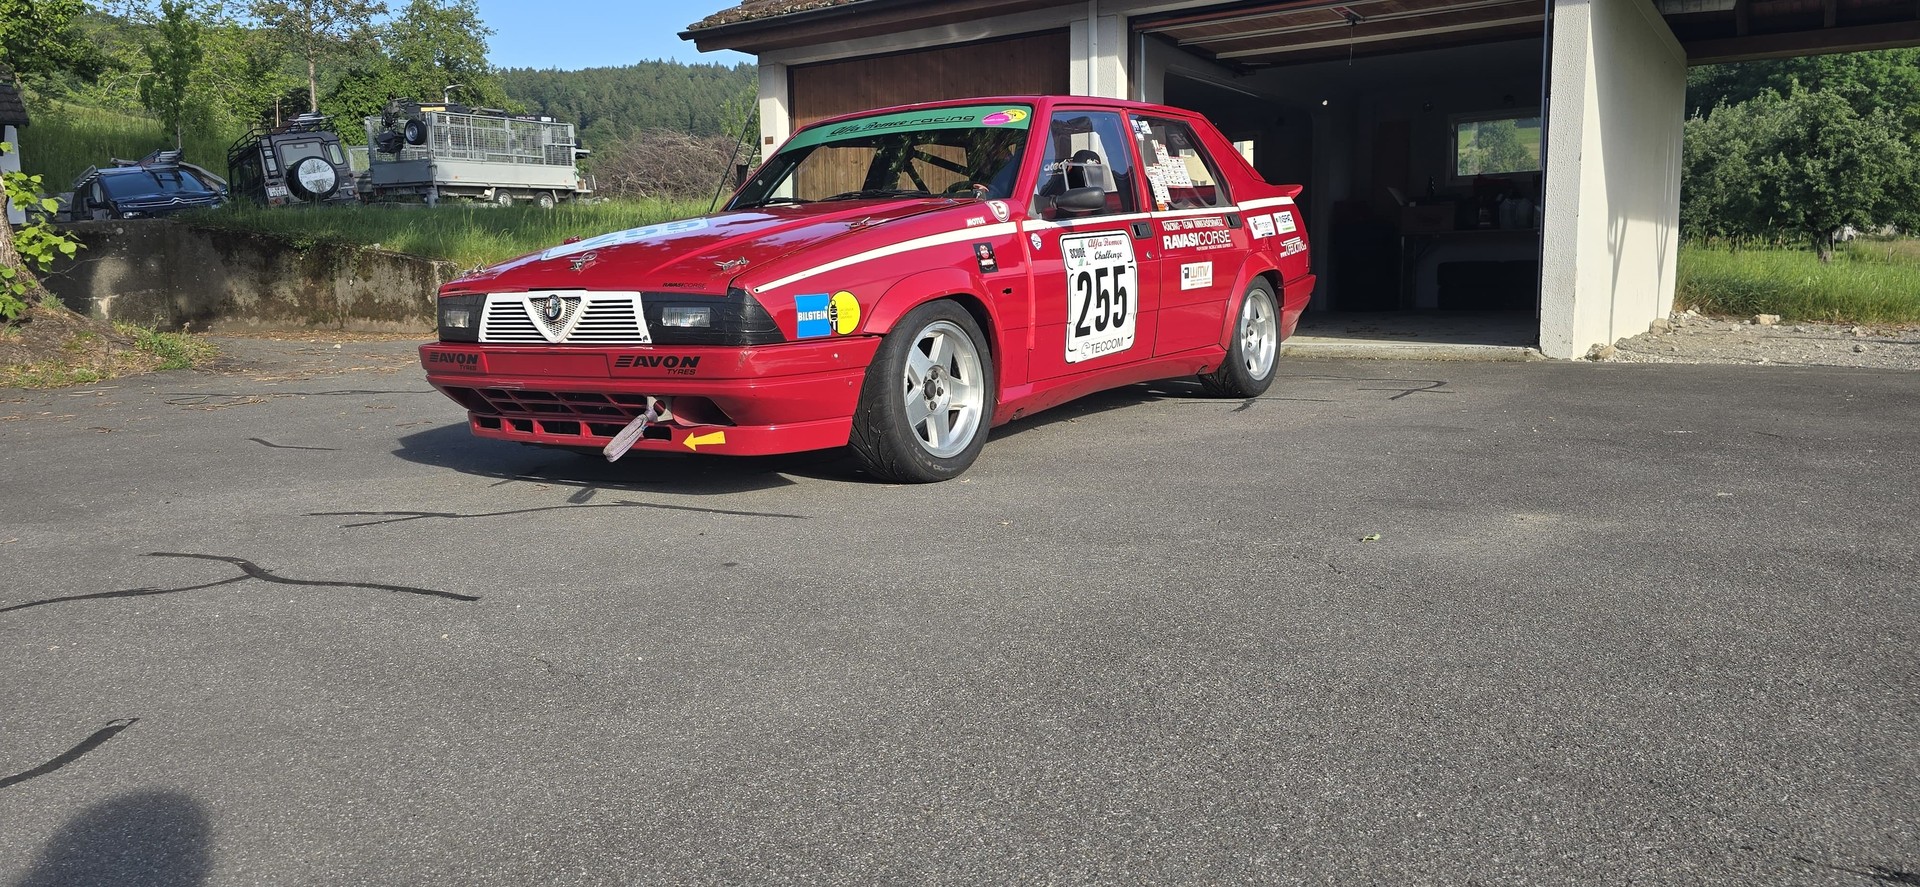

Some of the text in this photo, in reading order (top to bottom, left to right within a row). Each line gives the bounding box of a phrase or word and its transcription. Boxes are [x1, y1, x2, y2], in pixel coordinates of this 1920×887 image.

[829, 125, 860, 136] Alfa
[863, 121, 907, 131] Romeo
[910, 115, 975, 126] racing
[966, 217, 986, 227] MOTUL
[1088, 238, 1102, 249] Alfa
[1163, 229, 1232, 250] RAVASICORSE
[1075, 265, 1127, 338] 255
[798, 310, 828, 322] BILSTEIN
[1091, 337, 1124, 354] TECCOM
[439, 352, 479, 364] AVON
[632, 355, 701, 368] AVON
[667, 368, 697, 376] TYRES
